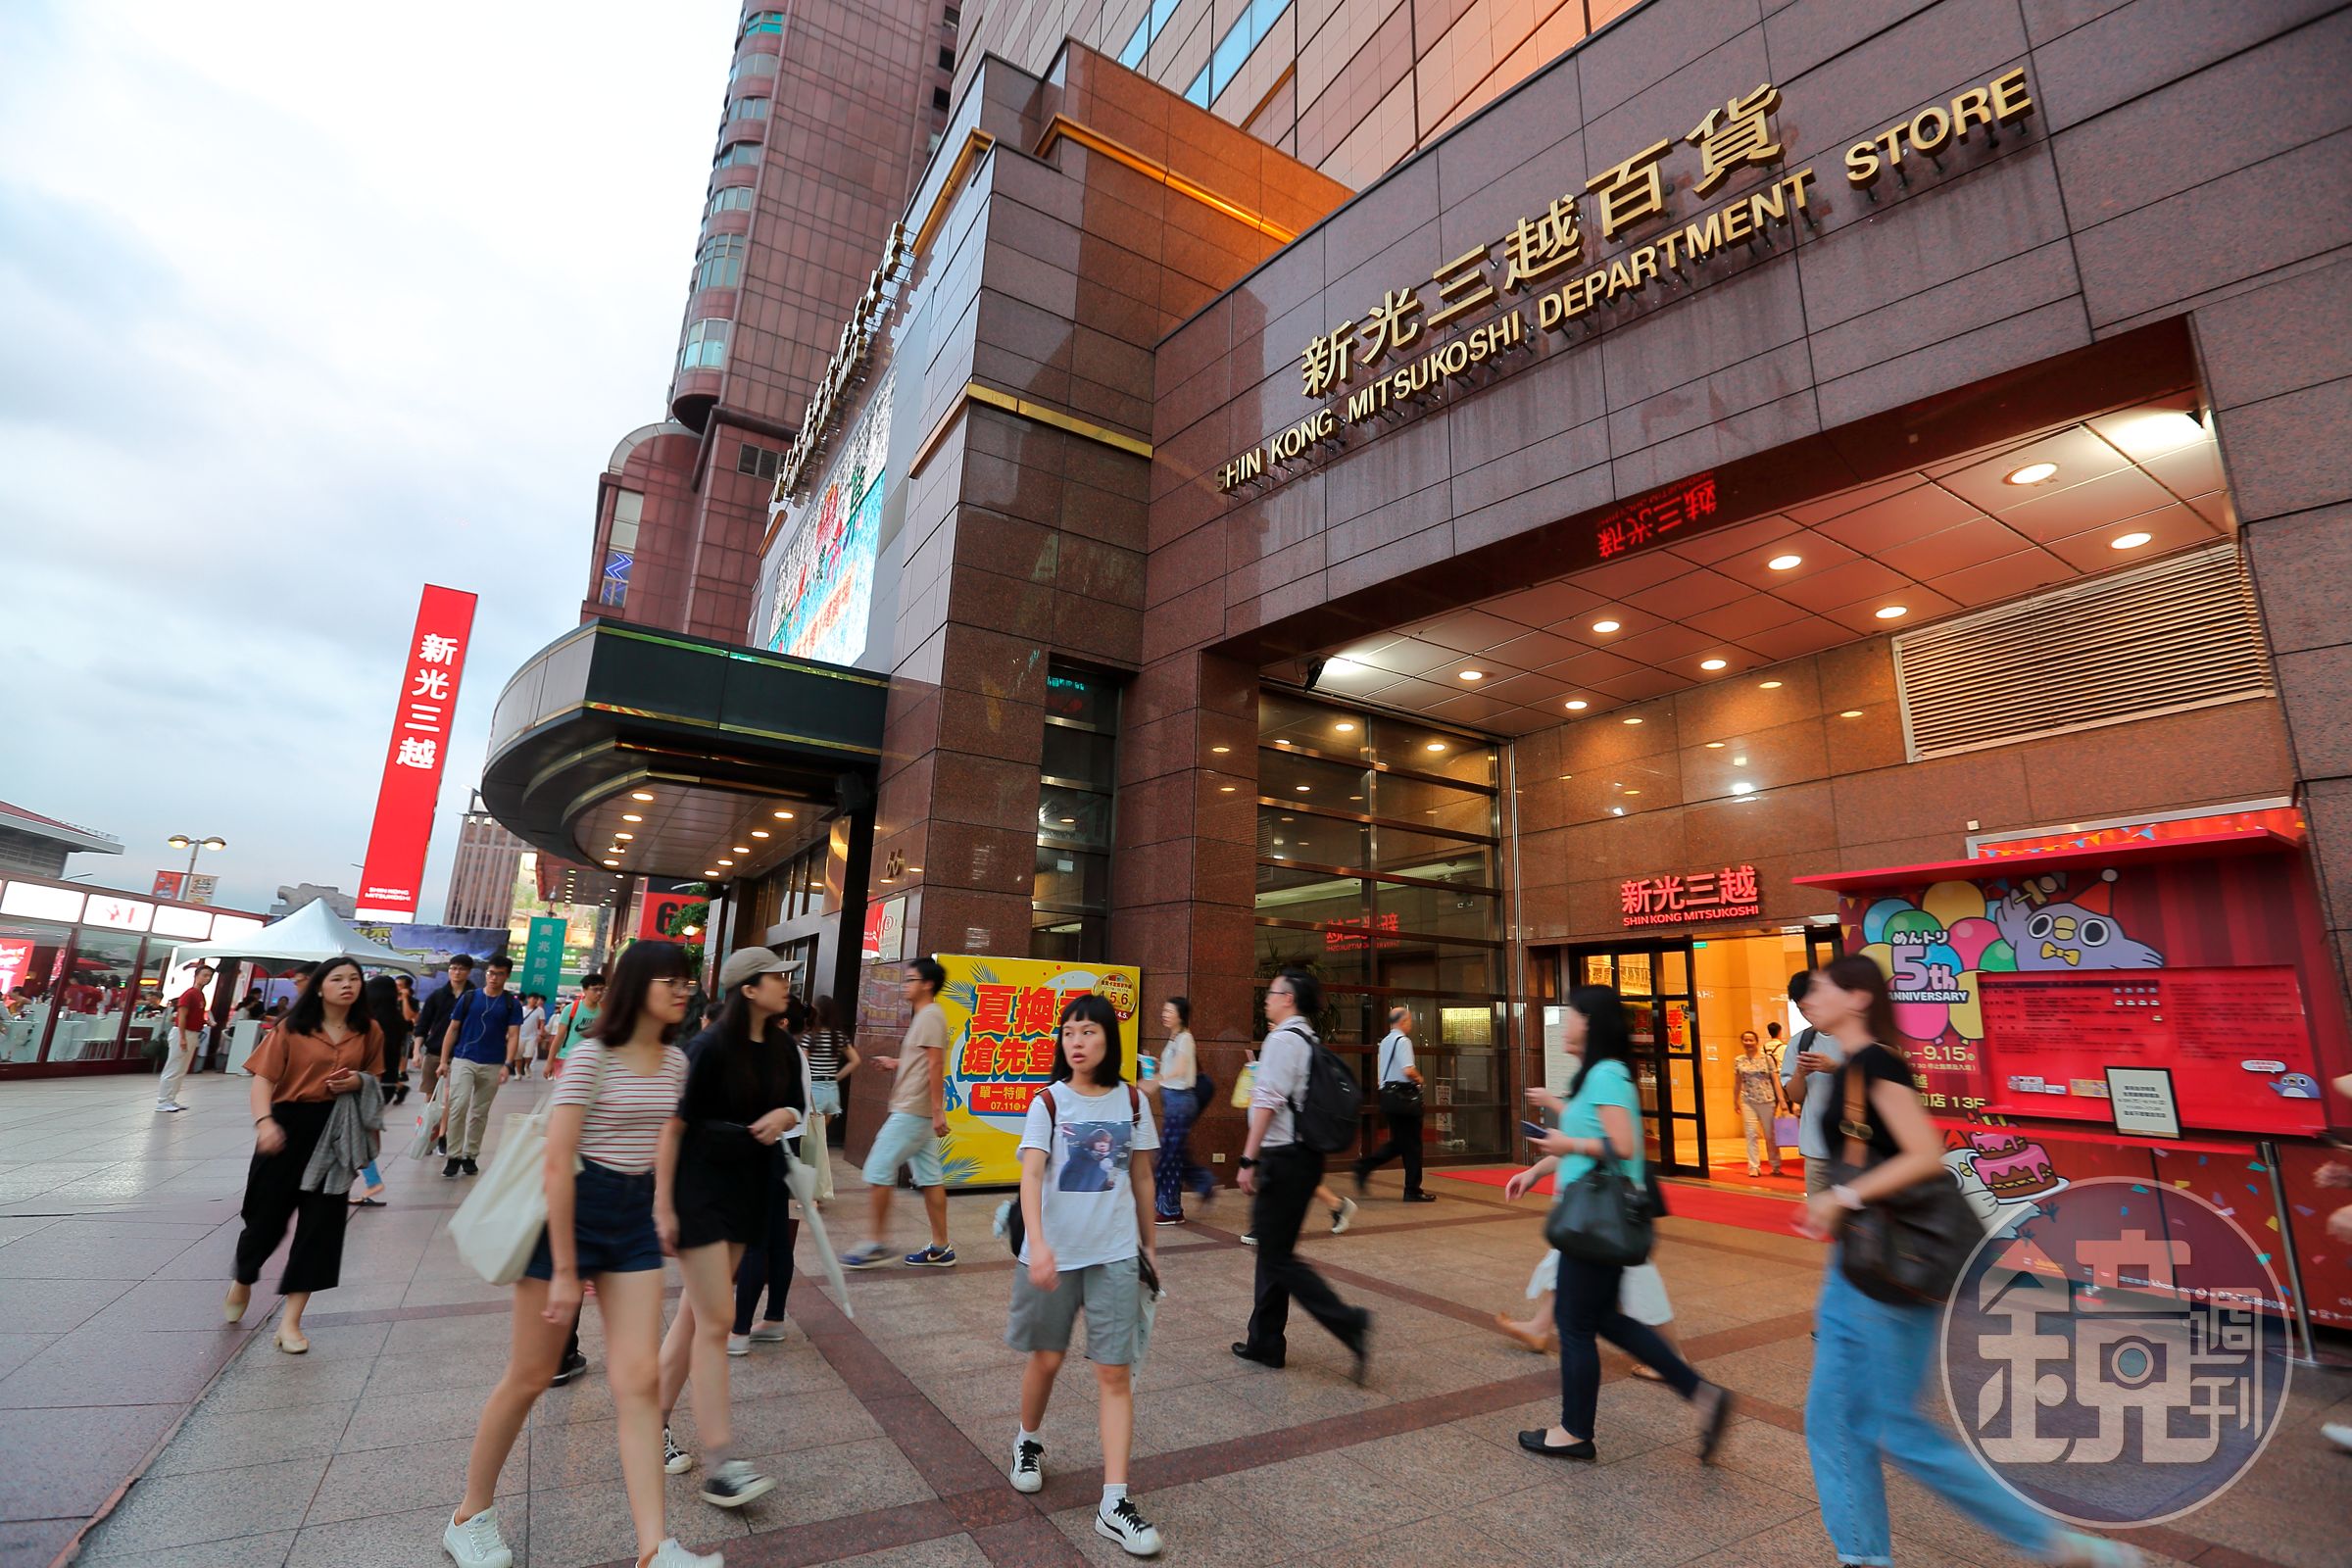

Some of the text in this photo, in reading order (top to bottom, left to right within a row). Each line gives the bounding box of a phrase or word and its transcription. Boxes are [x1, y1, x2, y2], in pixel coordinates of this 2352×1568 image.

[1301, 83, 1782, 398] 新光三越百貨
[1271, 408, 1336, 466] KONG
[1348, 310, 1522, 424] MITSUKOSHI
[1538, 167, 1814, 331] DEPARTMENT
[1844, 67, 2034, 186] STORE
[395, 632, 459, 770] 新光三越
[365, 892, 412, 902] MITSUKOSHI
[1621, 864, 1758, 914] 新光三越
[1623, 905, 1759, 926] SHIN KONG MITSUKOSHI
[1892, 931, 1948, 945] めんトリ
[532, 924, 554, 986] 美兆診所
[1892, 945, 1958, 991] 5th
[979, 1085, 1027, 1100] 單一特價
[1952, 1097, 1985, 1108] 13F
